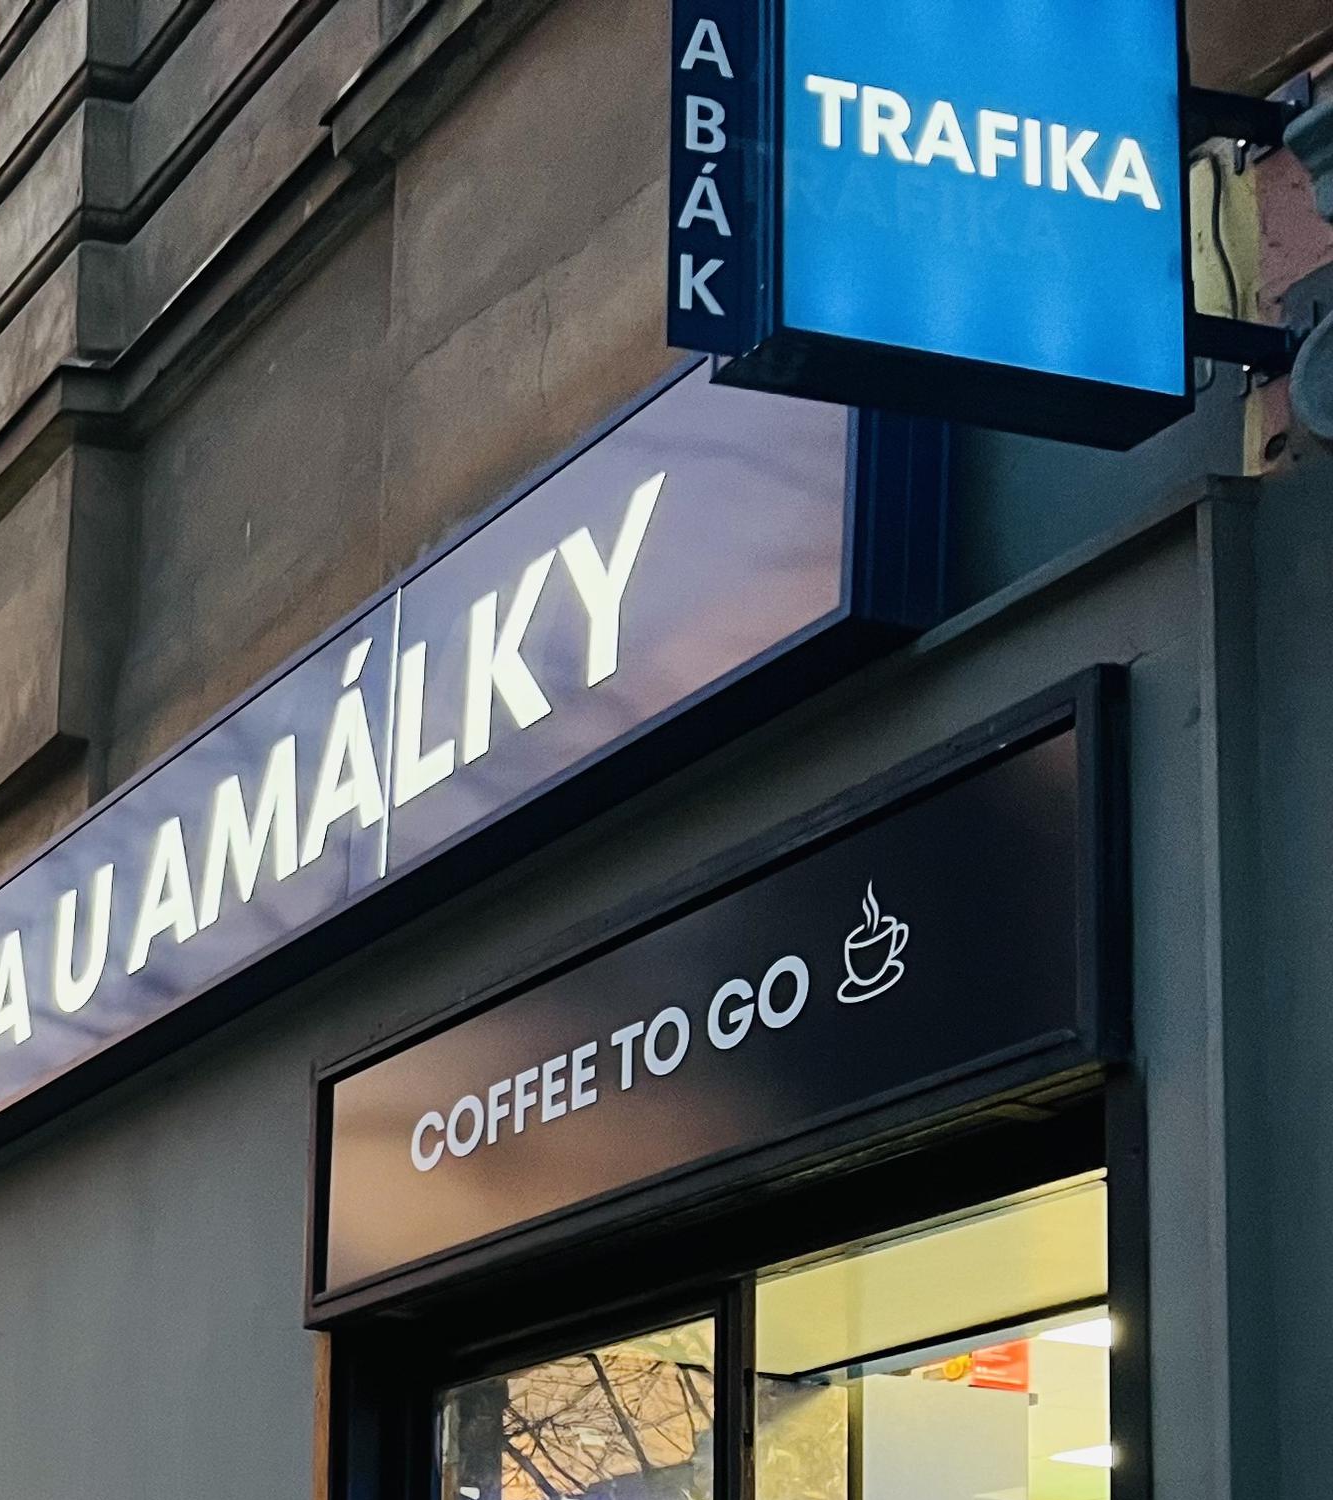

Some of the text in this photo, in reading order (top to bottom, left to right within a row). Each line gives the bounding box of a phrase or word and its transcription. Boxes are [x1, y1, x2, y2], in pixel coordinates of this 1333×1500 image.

[805, 73, 1162, 211] TRAFIKA
[49, 863, 115, 1013] U
[127, 471, 667, 976] AMÁLKY
[410, 955, 810, 1172] COFFEE TO GO
